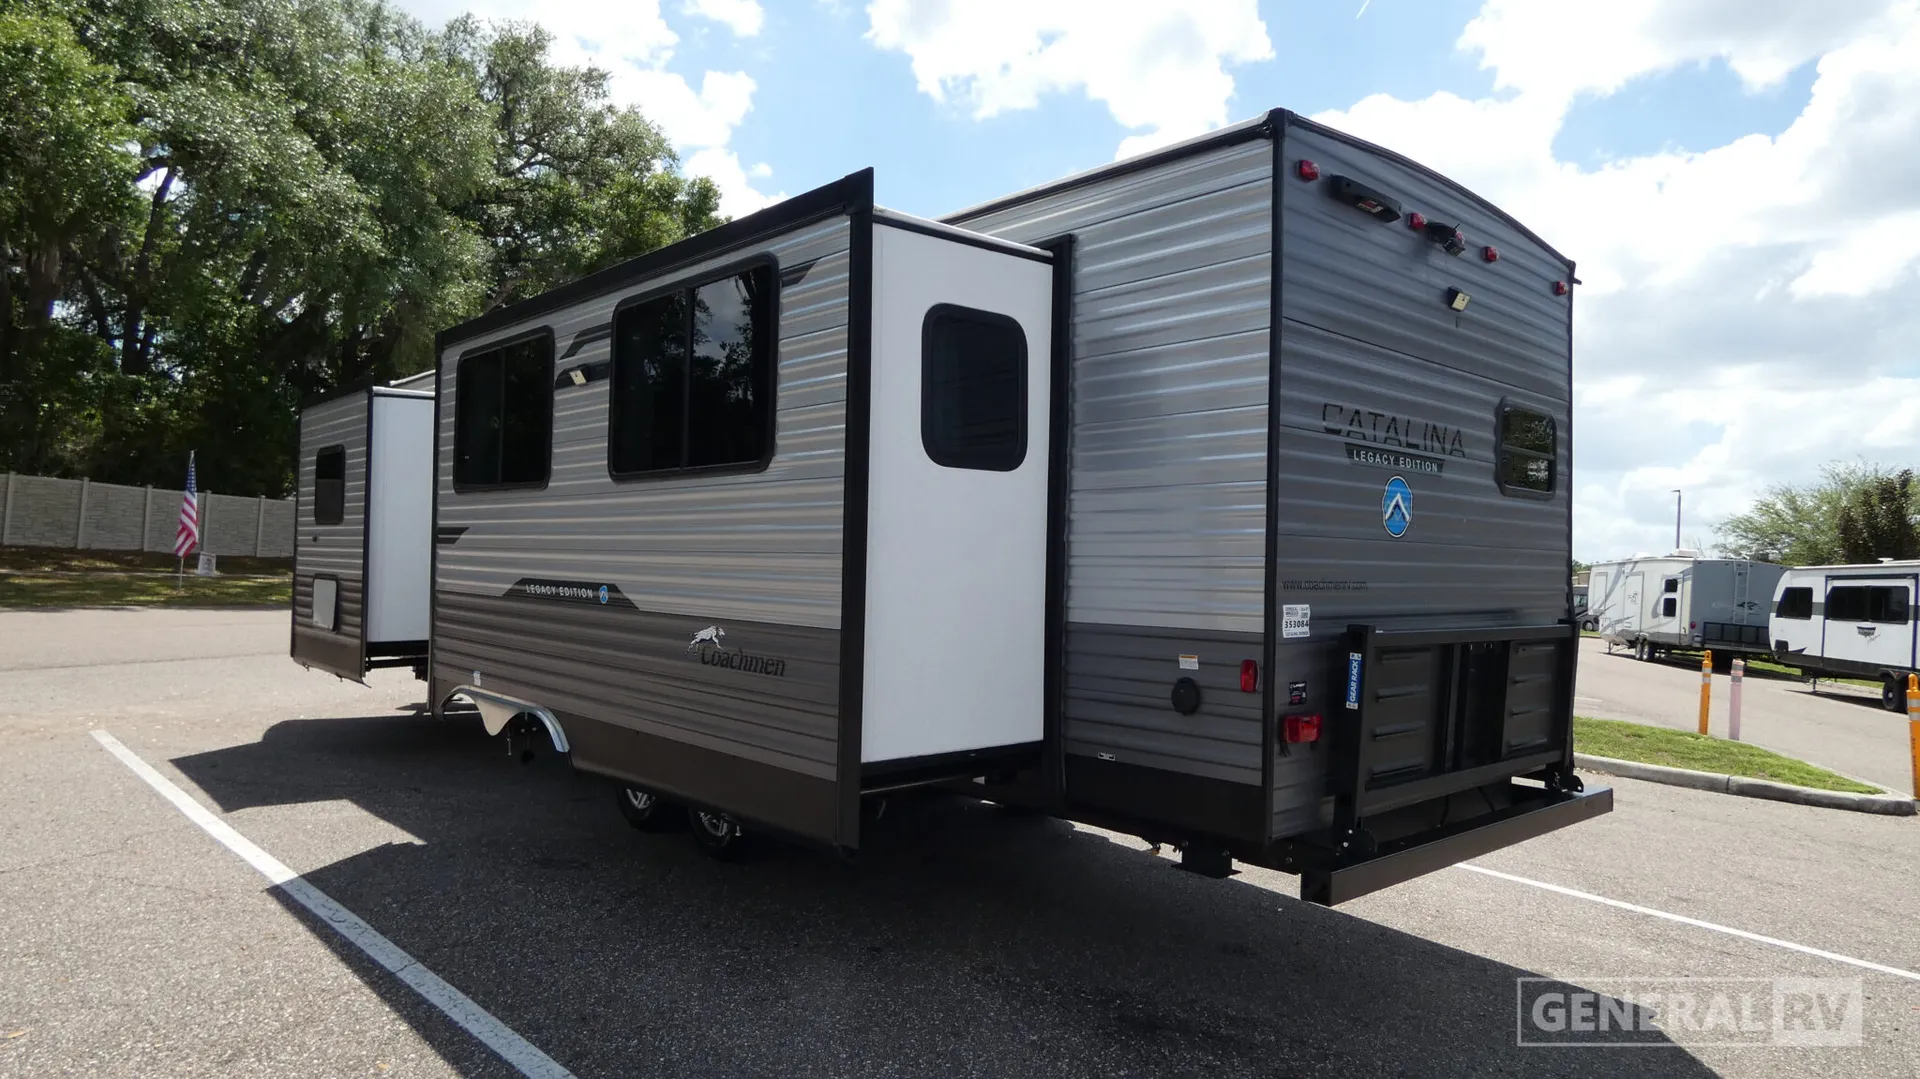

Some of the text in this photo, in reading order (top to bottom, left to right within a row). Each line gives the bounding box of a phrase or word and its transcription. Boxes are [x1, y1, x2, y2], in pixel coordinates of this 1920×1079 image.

[1322, 402, 1466, 458] CATALINA
[1353, 449, 1438, 472] LEGACY EDITION
[525, 584, 593, 598] LEGACY EDITION
[1284, 620, 1309, 629] 353084
[701, 646, 786, 677] Coachmen
[1351, 660, 1359, 682] RACK
[1350, 682, 1358, 702] GEAR
